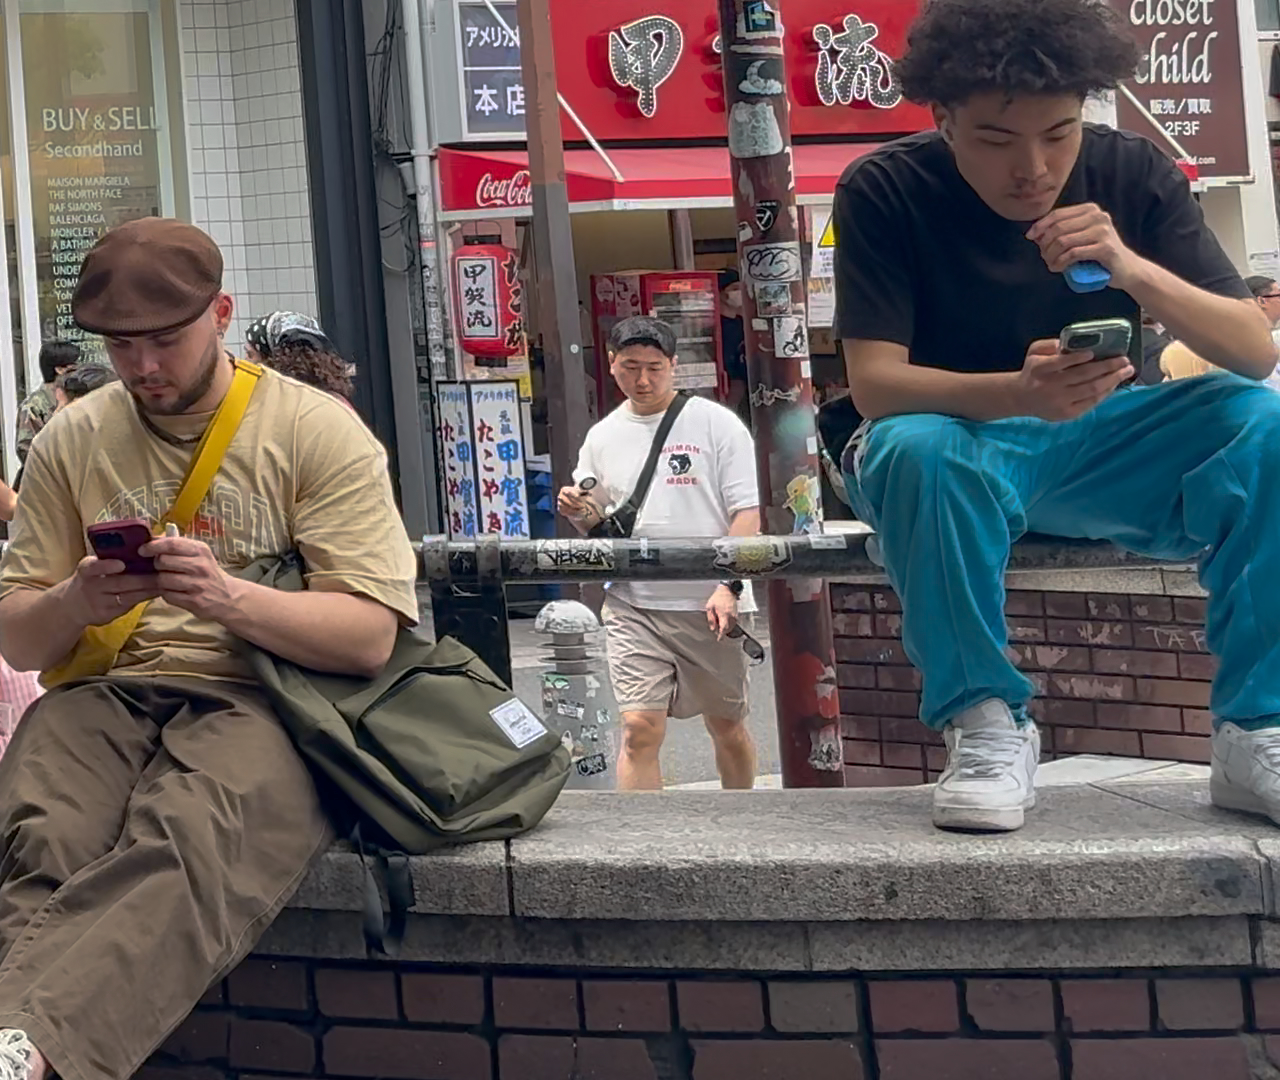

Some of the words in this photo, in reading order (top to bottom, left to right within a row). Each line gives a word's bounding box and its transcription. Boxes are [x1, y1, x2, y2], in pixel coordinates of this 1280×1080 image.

[1134, 31, 1219, 84] child
[474, 84, 525, 116] 本店
[42, 107, 89, 132] BUY
[93, 114, 106, 130] &
[108, 106, 162, 132] SELL
[1164, 121, 1200, 136] 2F3F
[44, 139, 143, 159] Secondhand
[48, 177, 83, 187] MAISON
[84, 176, 130, 187] MARGIELA
[476, 170, 533, 207] Coca-Col
[49, 189, 65, 200] THE
[68, 189, 99, 199] NORTH
[100, 188, 123, 199] FACE
[49, 203, 66, 213] RAF
[68, 202, 103, 212] SIMONS
[49, 214, 106, 225] BALENCIAGA
[50, 226, 94, 238] MONCLER
[464, 264, 492, 328] 甲賀流
[477, 418, 502, 533] たこやき
[666, 477, 698, 486] MADE
[497, 439, 528, 537] 甲賀流
